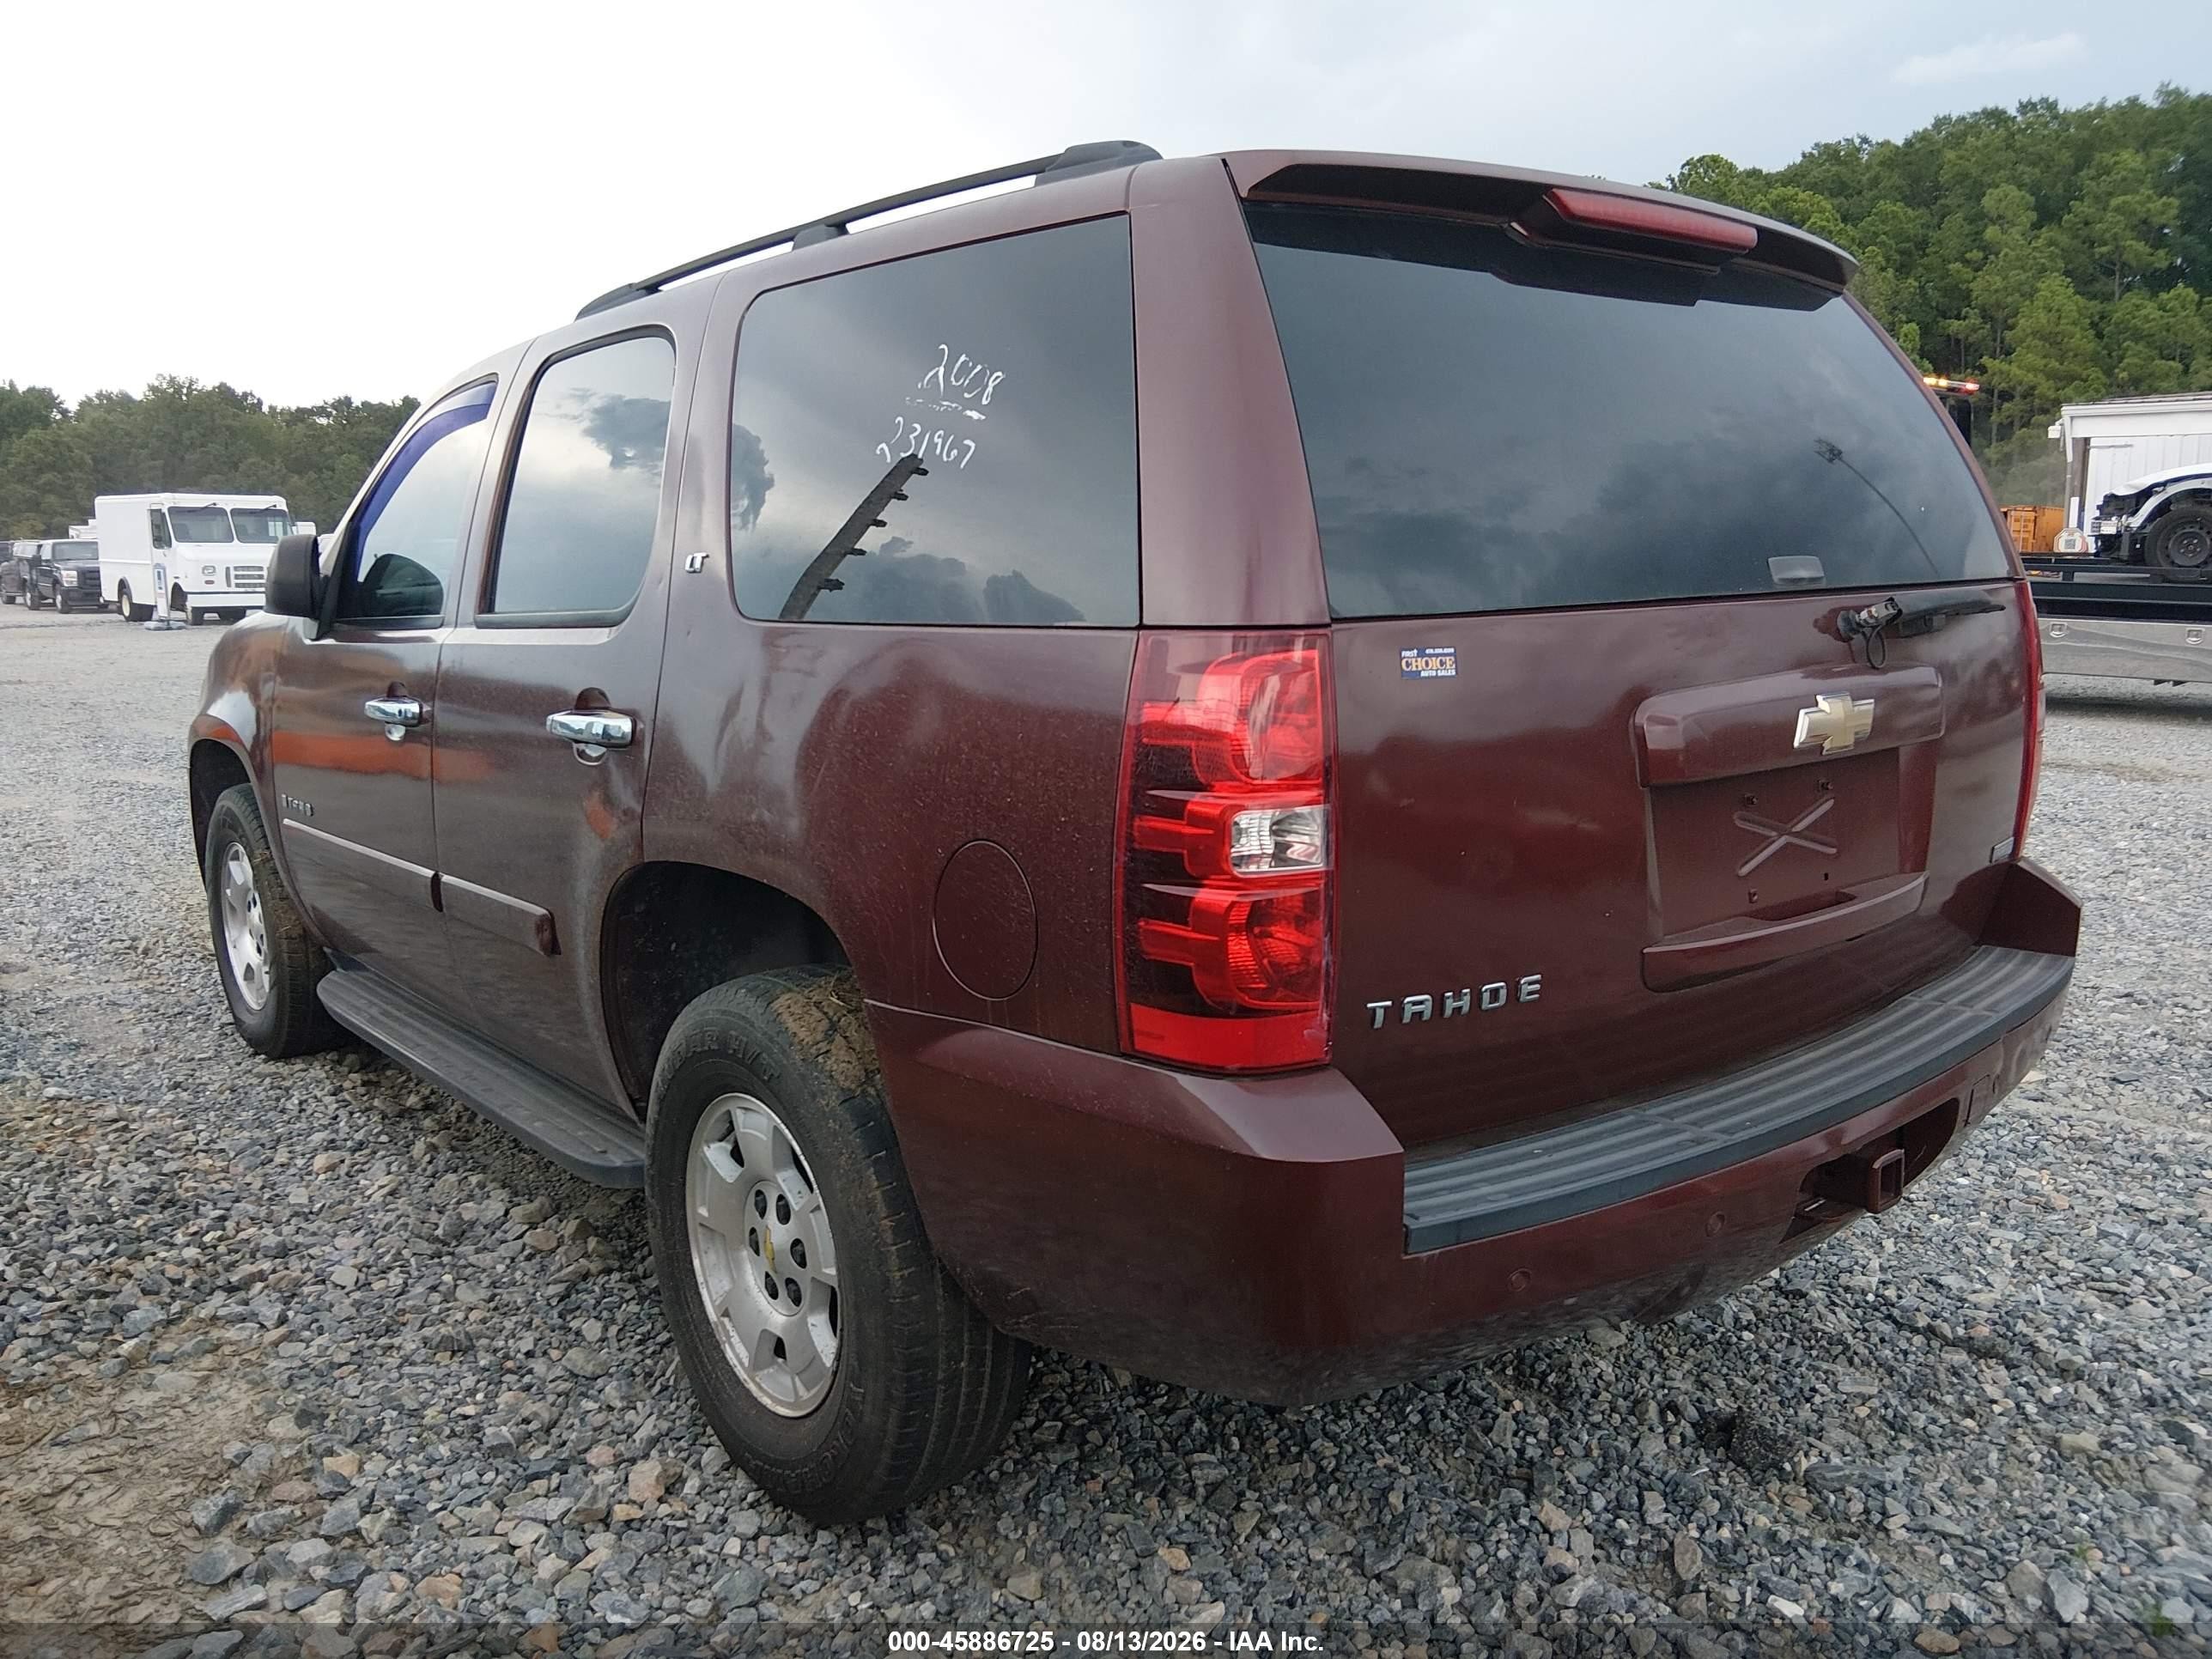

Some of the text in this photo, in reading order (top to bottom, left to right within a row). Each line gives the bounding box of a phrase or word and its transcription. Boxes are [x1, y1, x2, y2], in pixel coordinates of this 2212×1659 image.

[917, 343, 1006, 404] 2008
[876, 416, 975, 469] 231967
[684, 552, 708, 574] LT
[1401, 657, 1456, 672] CHOICE
[1366, 974, 1542, 1029] TAHOE
